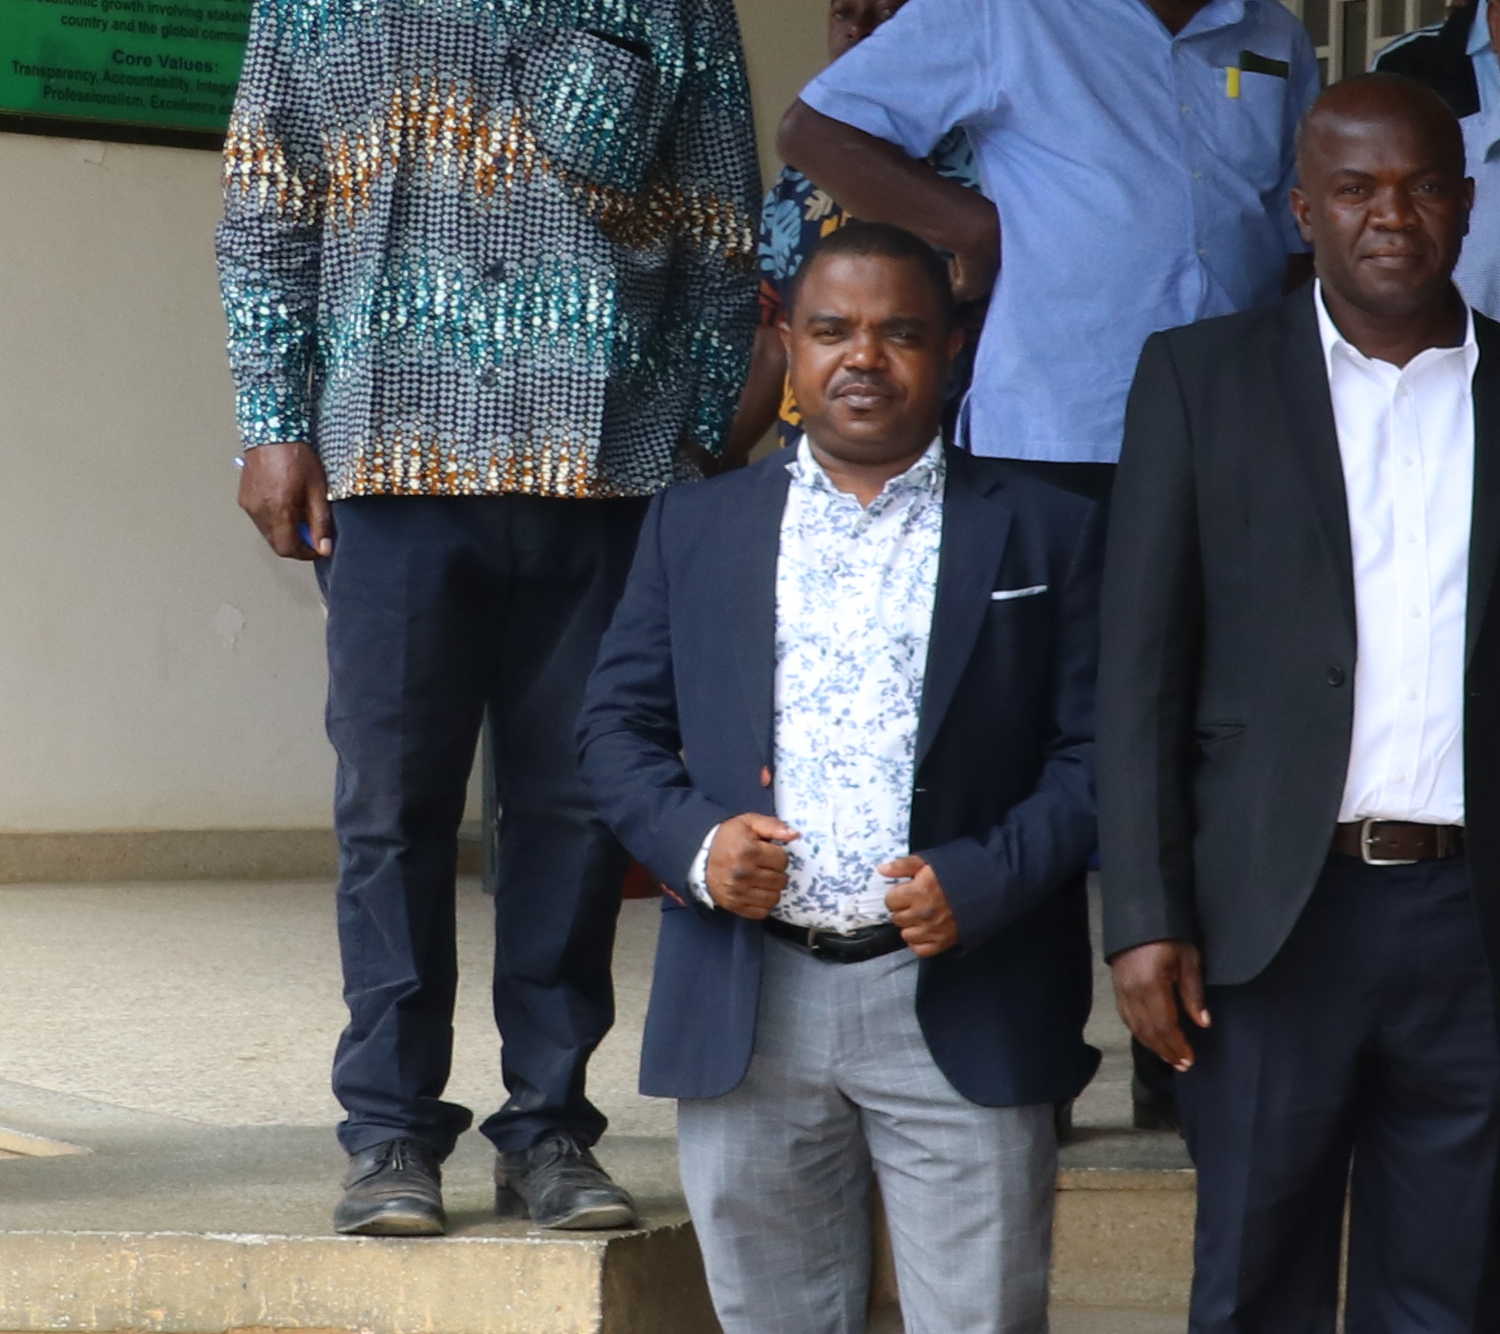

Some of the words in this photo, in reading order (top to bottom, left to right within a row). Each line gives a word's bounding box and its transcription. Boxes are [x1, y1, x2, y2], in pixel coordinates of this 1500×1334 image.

[147, 0, 203, 22] involving
[61, 14, 108, 32] country
[112, 19, 135, 32] and
[138, 21, 158, 34] the
[161, 23, 198, 39] global
[111, 49, 153, 67] Core
[158, 54, 219, 73] Values:
